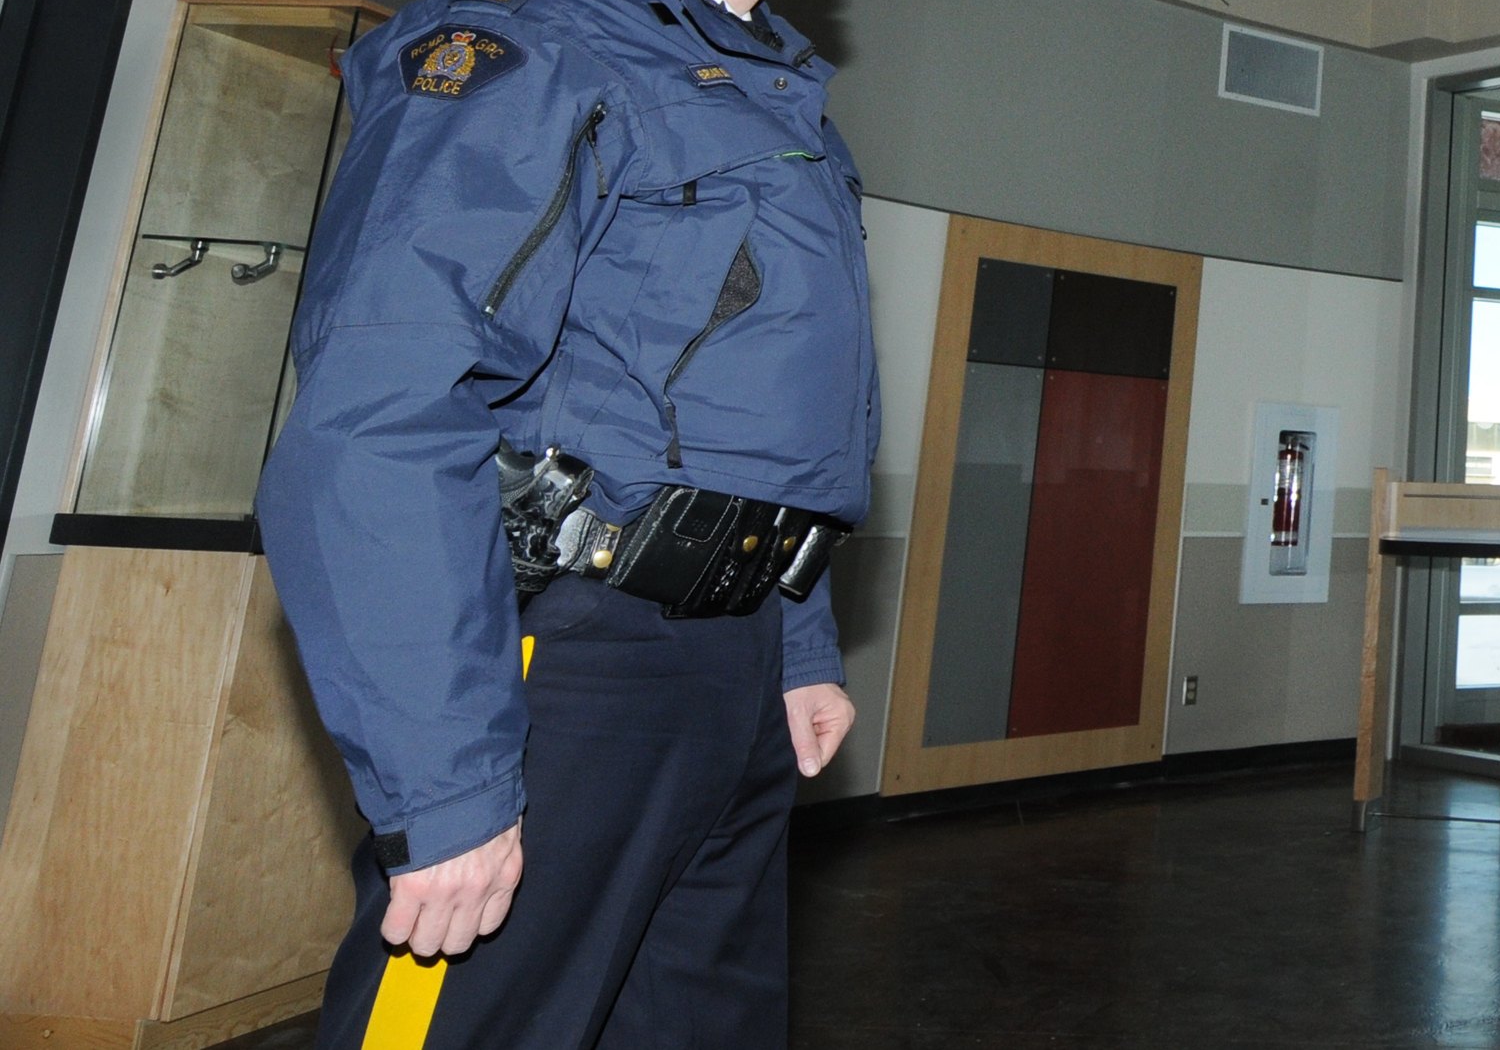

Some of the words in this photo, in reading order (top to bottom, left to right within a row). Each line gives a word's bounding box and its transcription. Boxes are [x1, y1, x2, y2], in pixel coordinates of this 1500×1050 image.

[410, 33, 445, 60] RCMP
[475, 38, 505, 60] GRC
[412, 76, 464, 95] POLICE
